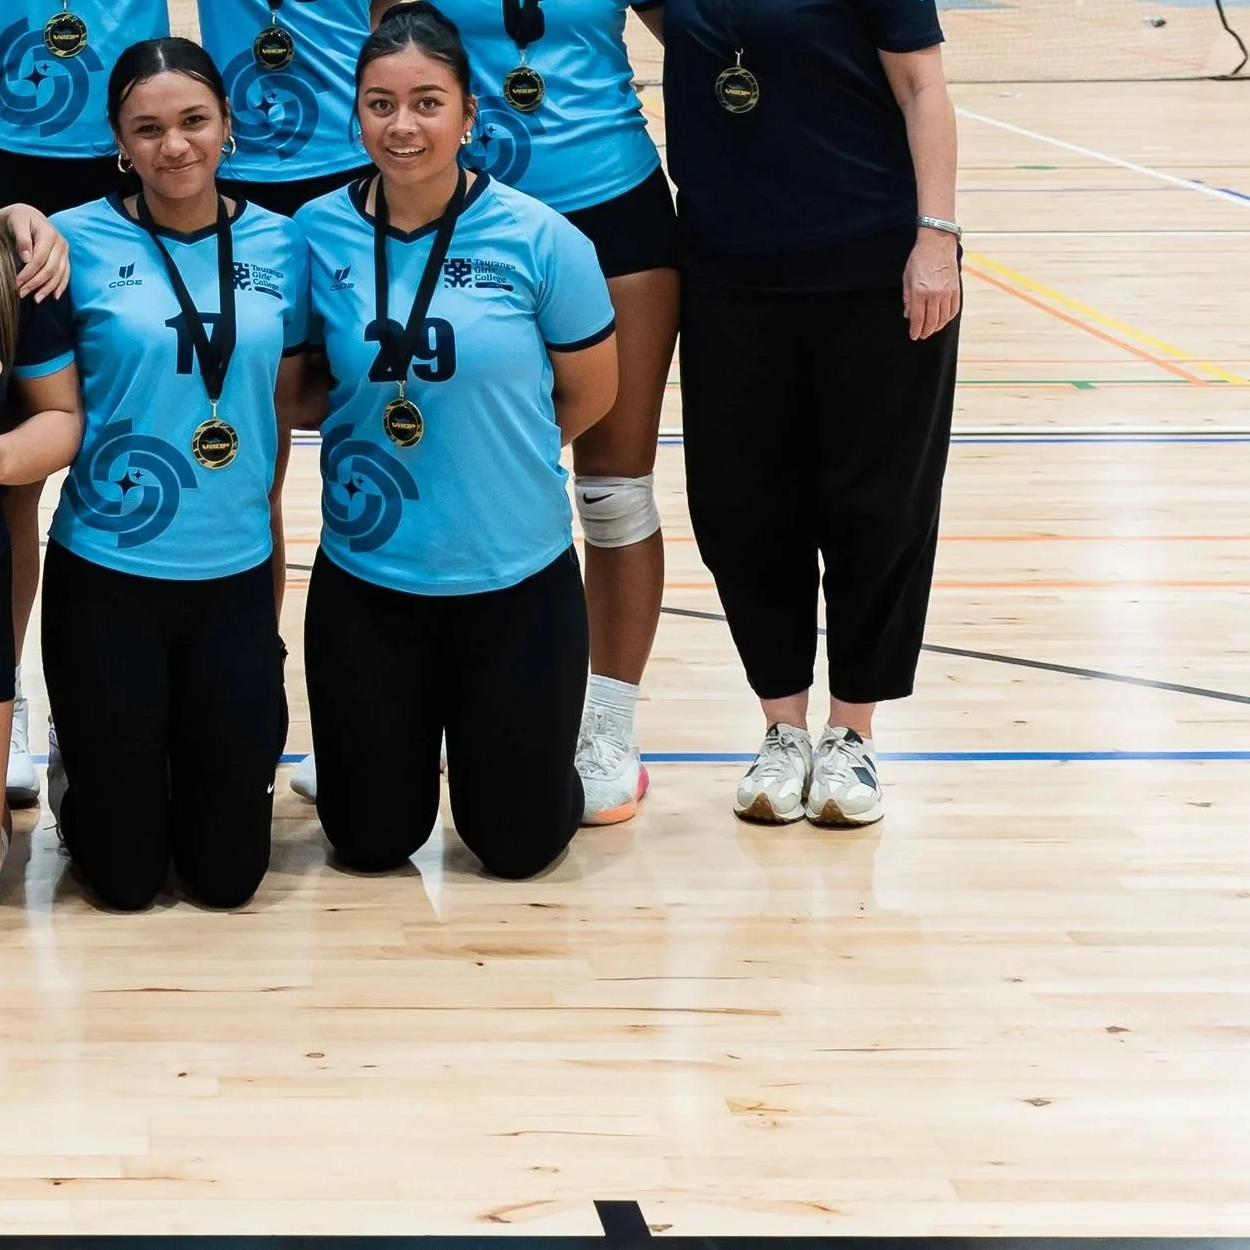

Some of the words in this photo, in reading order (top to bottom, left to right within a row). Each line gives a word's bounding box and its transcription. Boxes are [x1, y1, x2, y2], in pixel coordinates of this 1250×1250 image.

[474, 259, 516, 271] Tauranga
[475, 274, 507, 283] College
[109, 280, 142, 289] CODE
[364, 316, 458, 382] 29
